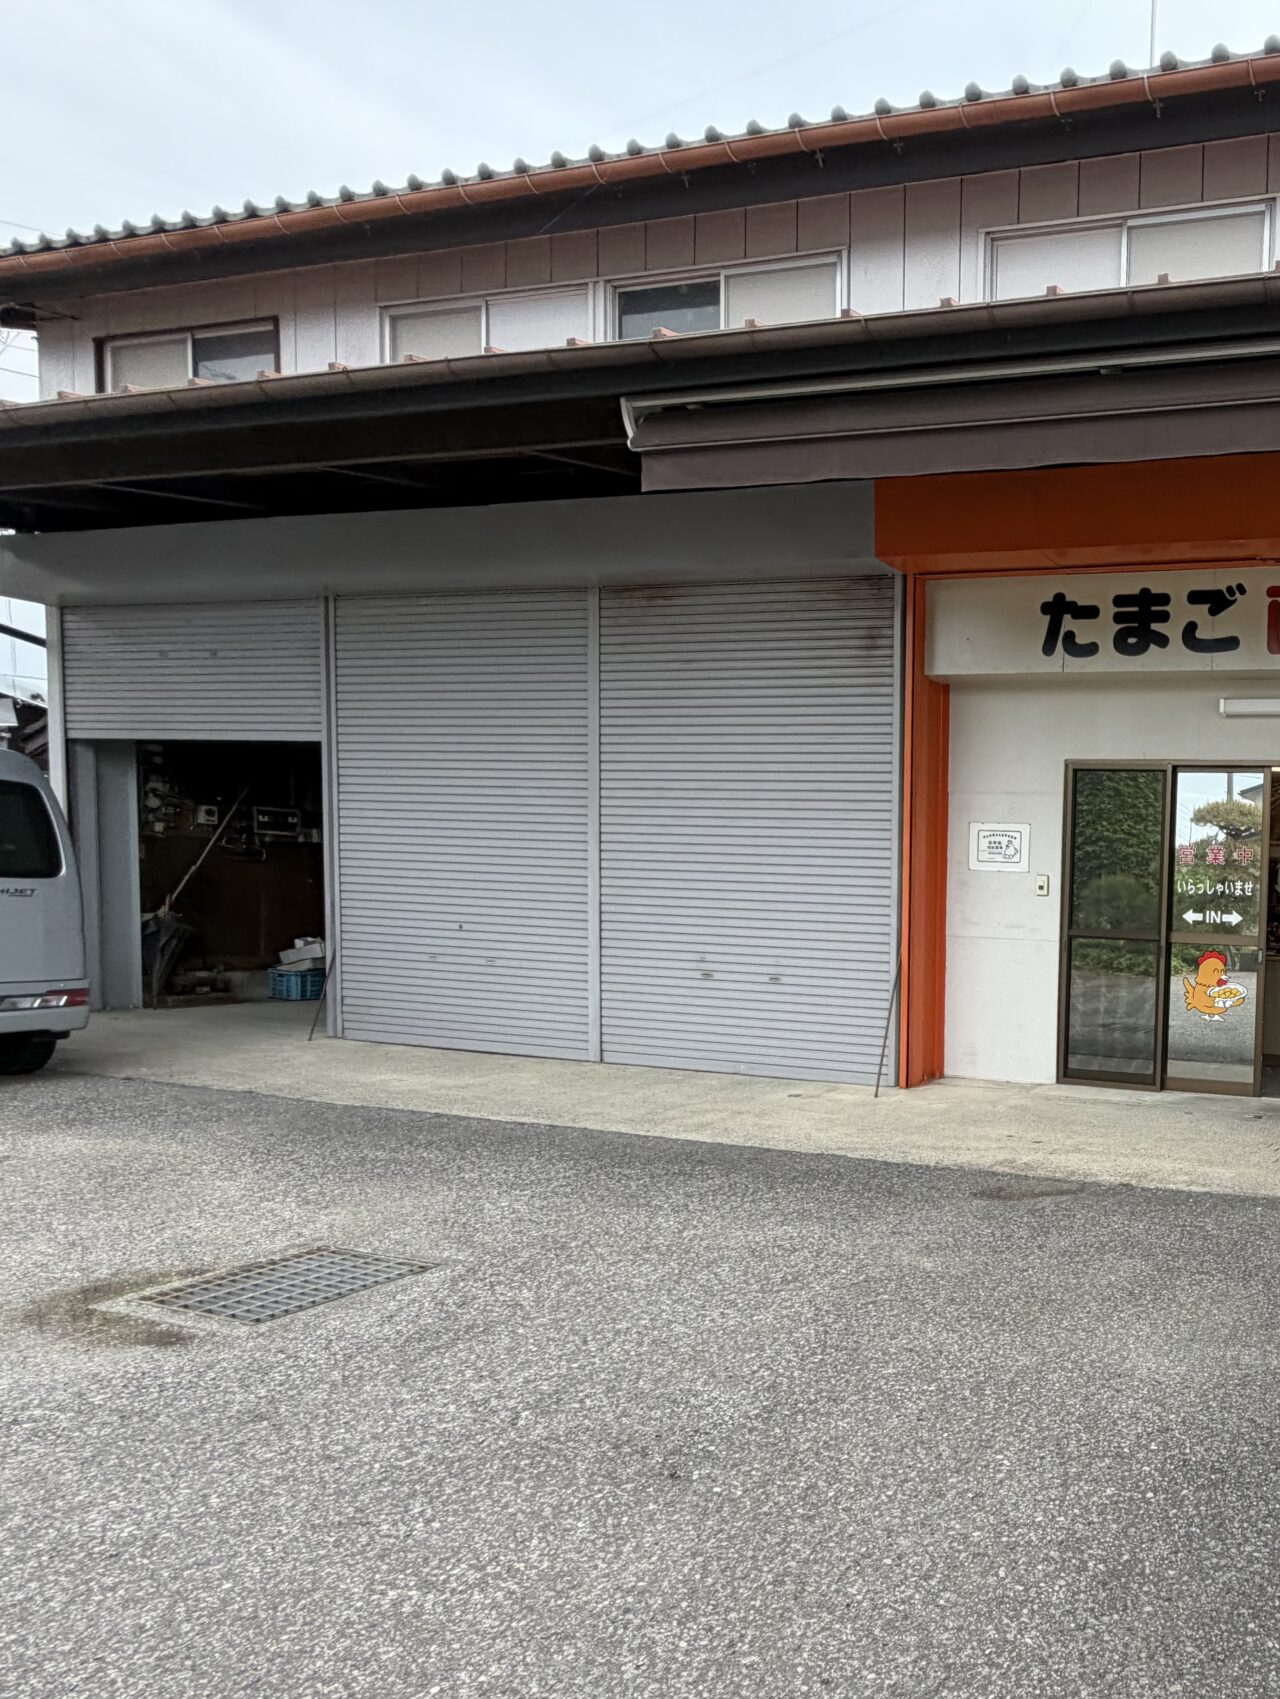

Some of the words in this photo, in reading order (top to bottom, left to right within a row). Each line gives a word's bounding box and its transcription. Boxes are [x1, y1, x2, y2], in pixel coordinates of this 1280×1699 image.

[1178, 845, 1254, 866] 営業中
[1177, 879, 1254, 896] いらっしゃいませ
[1205, 910, 1221, 924] IN
